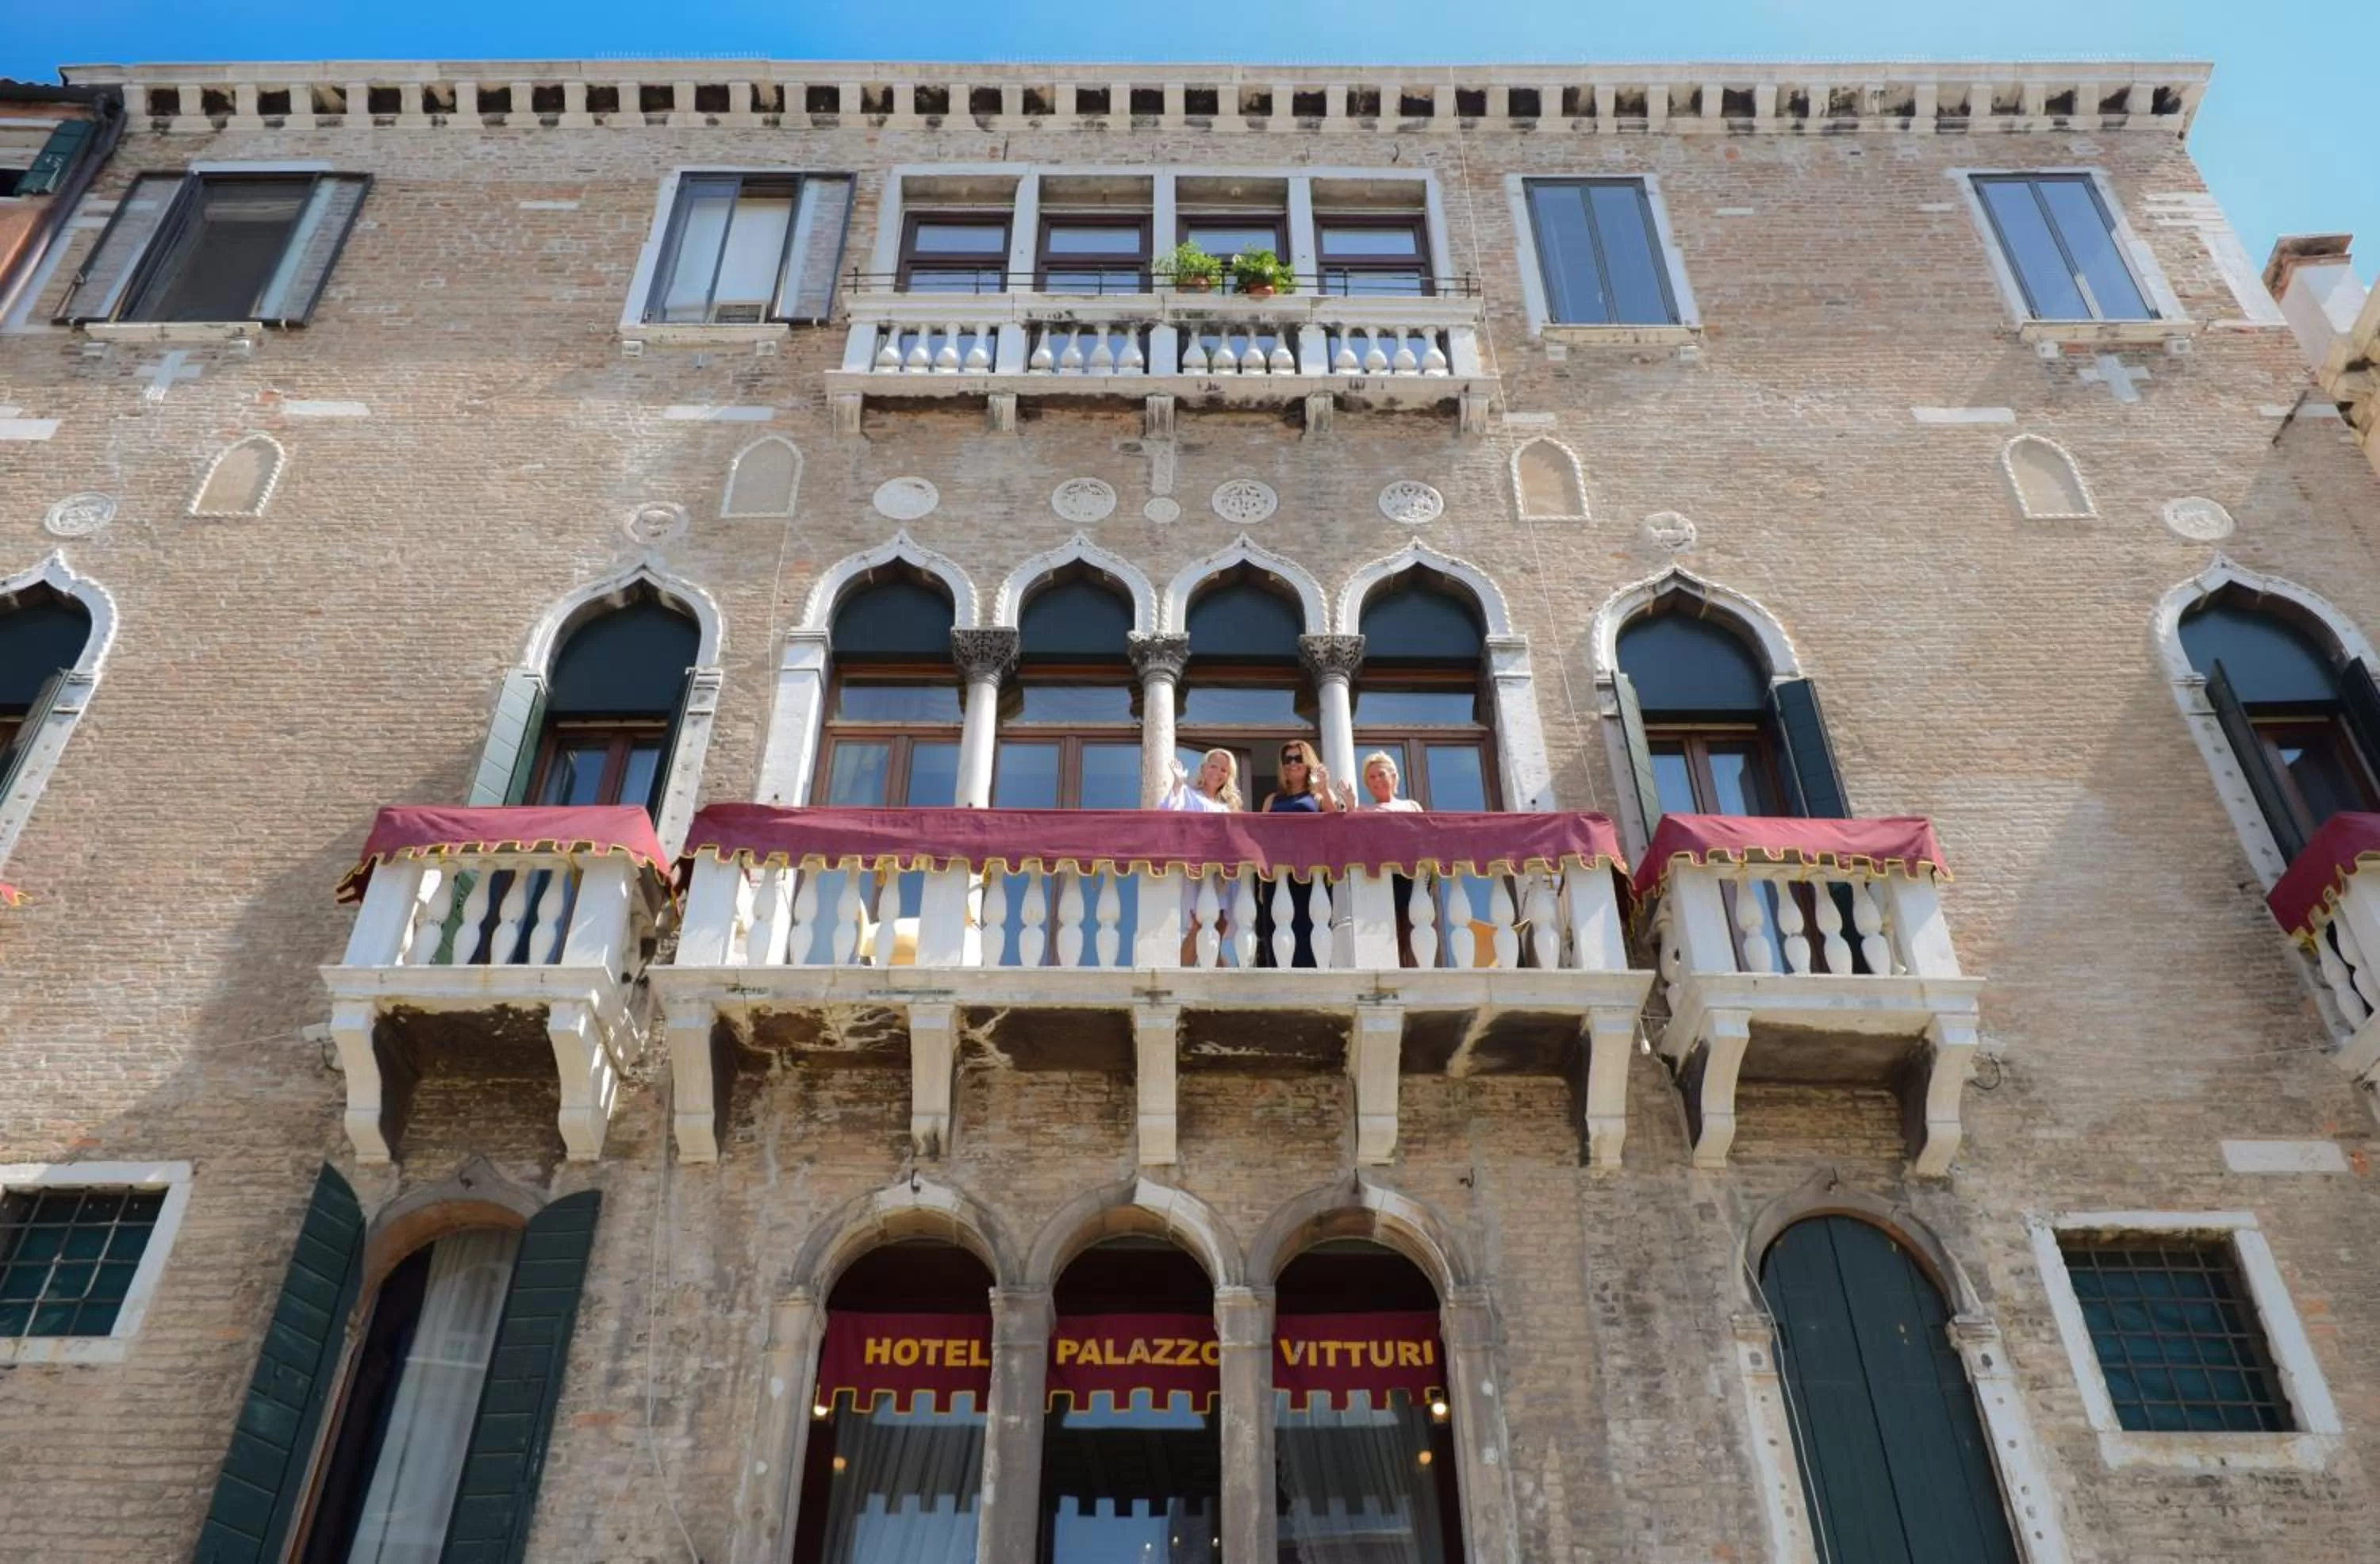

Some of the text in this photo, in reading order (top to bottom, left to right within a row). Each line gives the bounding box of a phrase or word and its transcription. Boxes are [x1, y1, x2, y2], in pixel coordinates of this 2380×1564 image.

[865, 1337, 1434, 1368] HOTEL PALAZZO VITTURI
